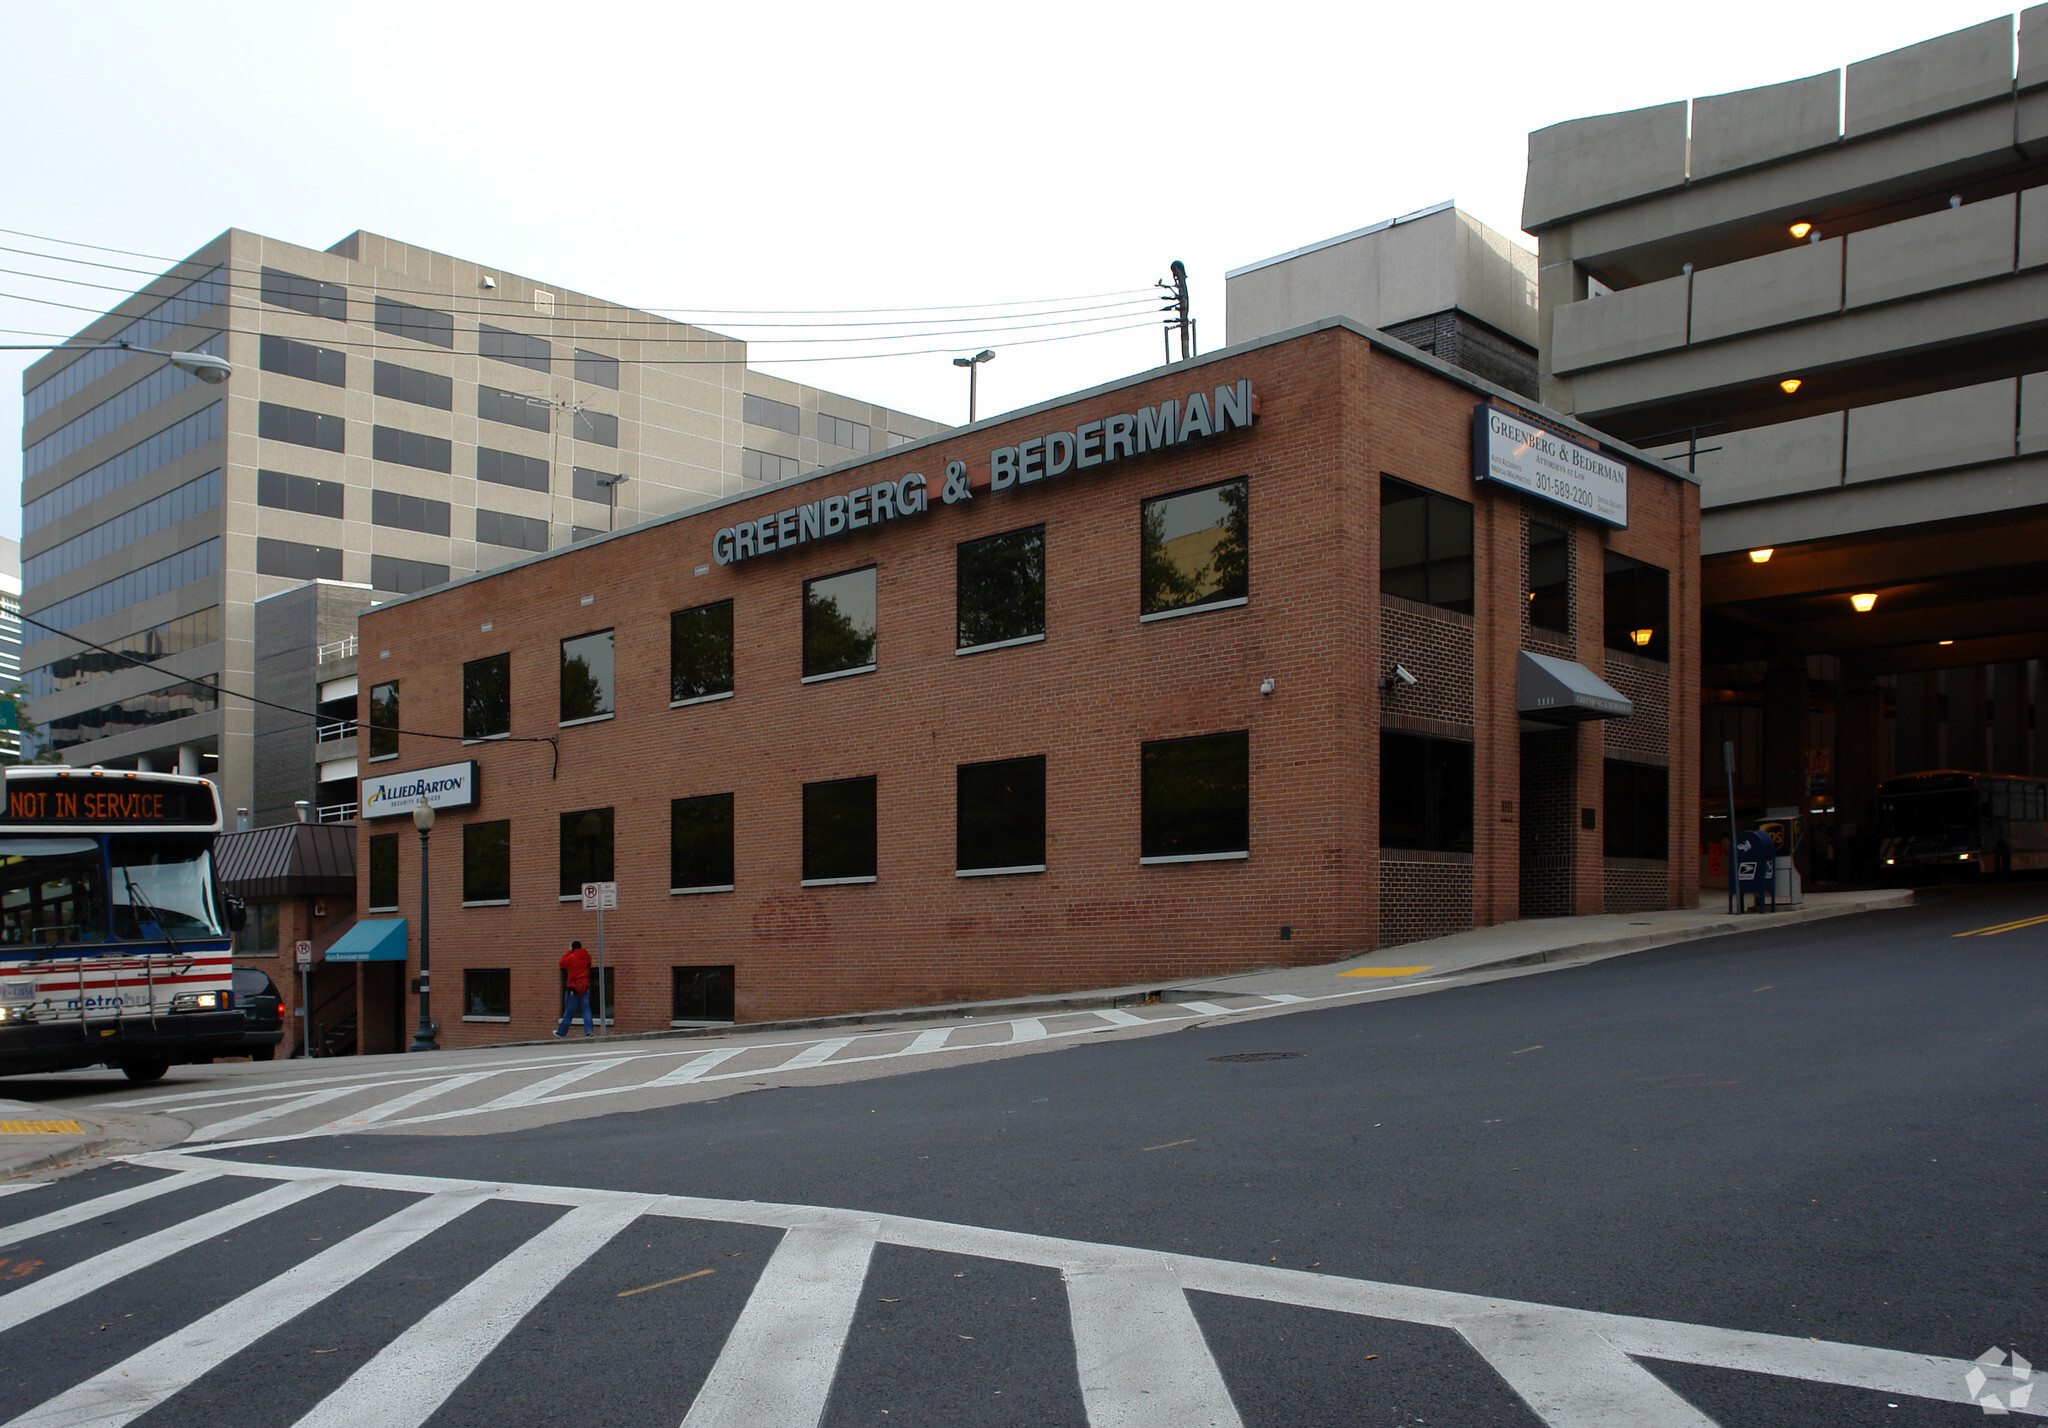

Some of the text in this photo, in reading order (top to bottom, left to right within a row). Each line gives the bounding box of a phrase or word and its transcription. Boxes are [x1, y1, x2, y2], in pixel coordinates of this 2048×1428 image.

[1559, 443, 1569, 463] &
[711, 379, 1253, 566] GREENBERG & BEDERMAN
[1535, 471, 1594, 509] 301-589-2200
[10, 792, 164, 819] NOT IN SERVICE
